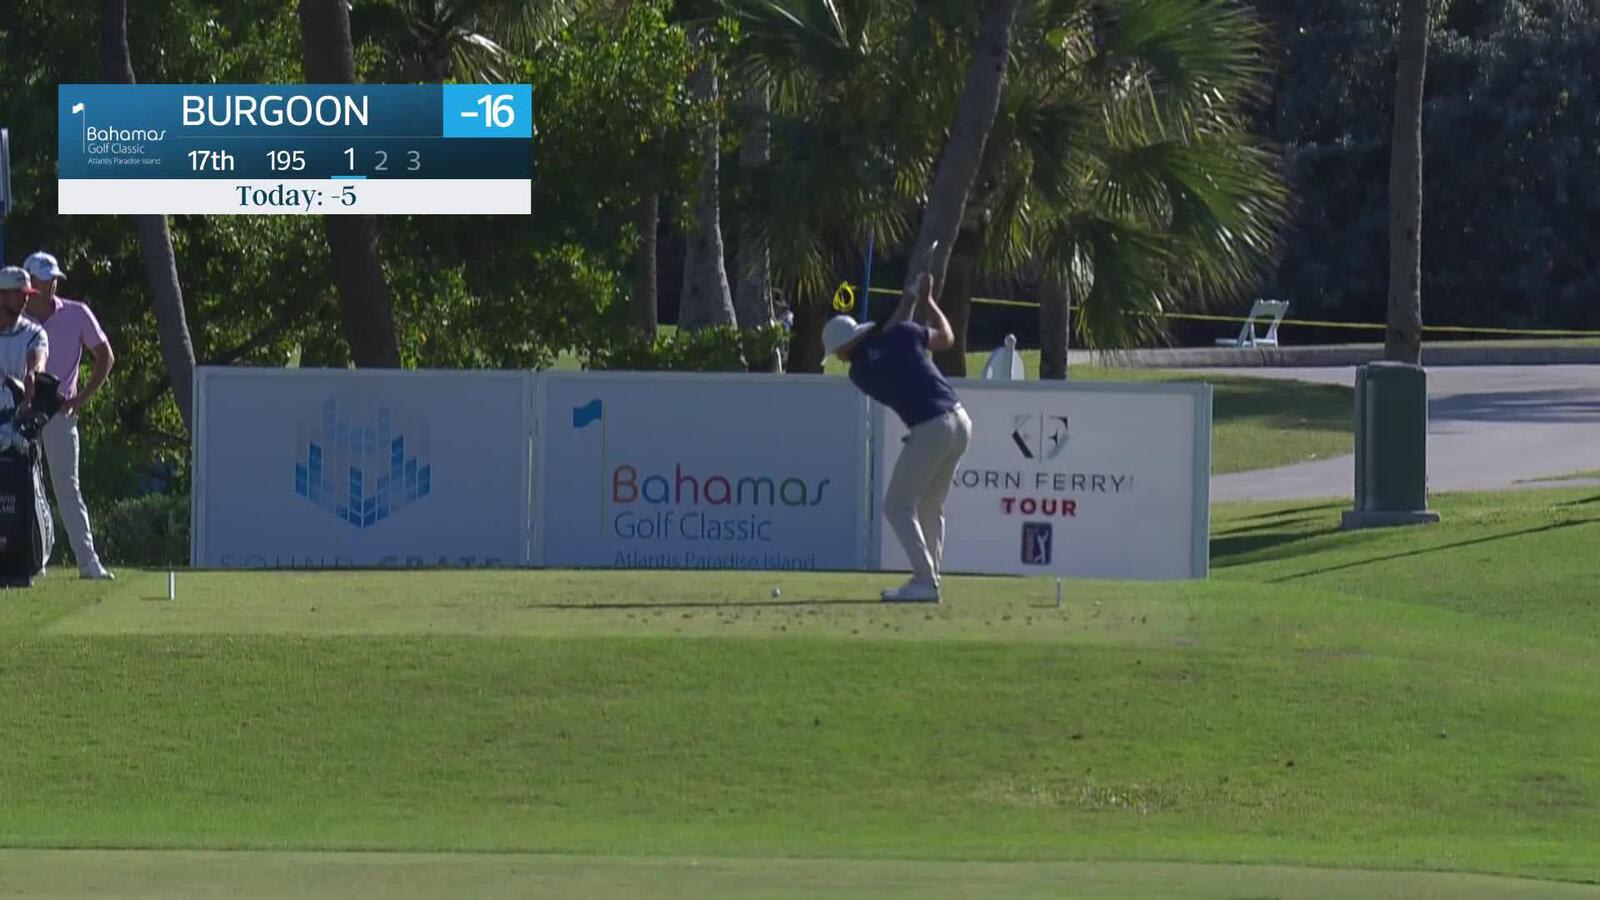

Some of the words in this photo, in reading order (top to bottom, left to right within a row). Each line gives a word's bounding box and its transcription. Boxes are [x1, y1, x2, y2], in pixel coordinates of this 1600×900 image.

[613, 463, 831, 506] Bahamas
[1035, 473, 1124, 493] FERRY
[1002, 497, 1077, 517] TOUR
[614, 511, 673, 540] Golf
[679, 511, 773, 541] Classic
